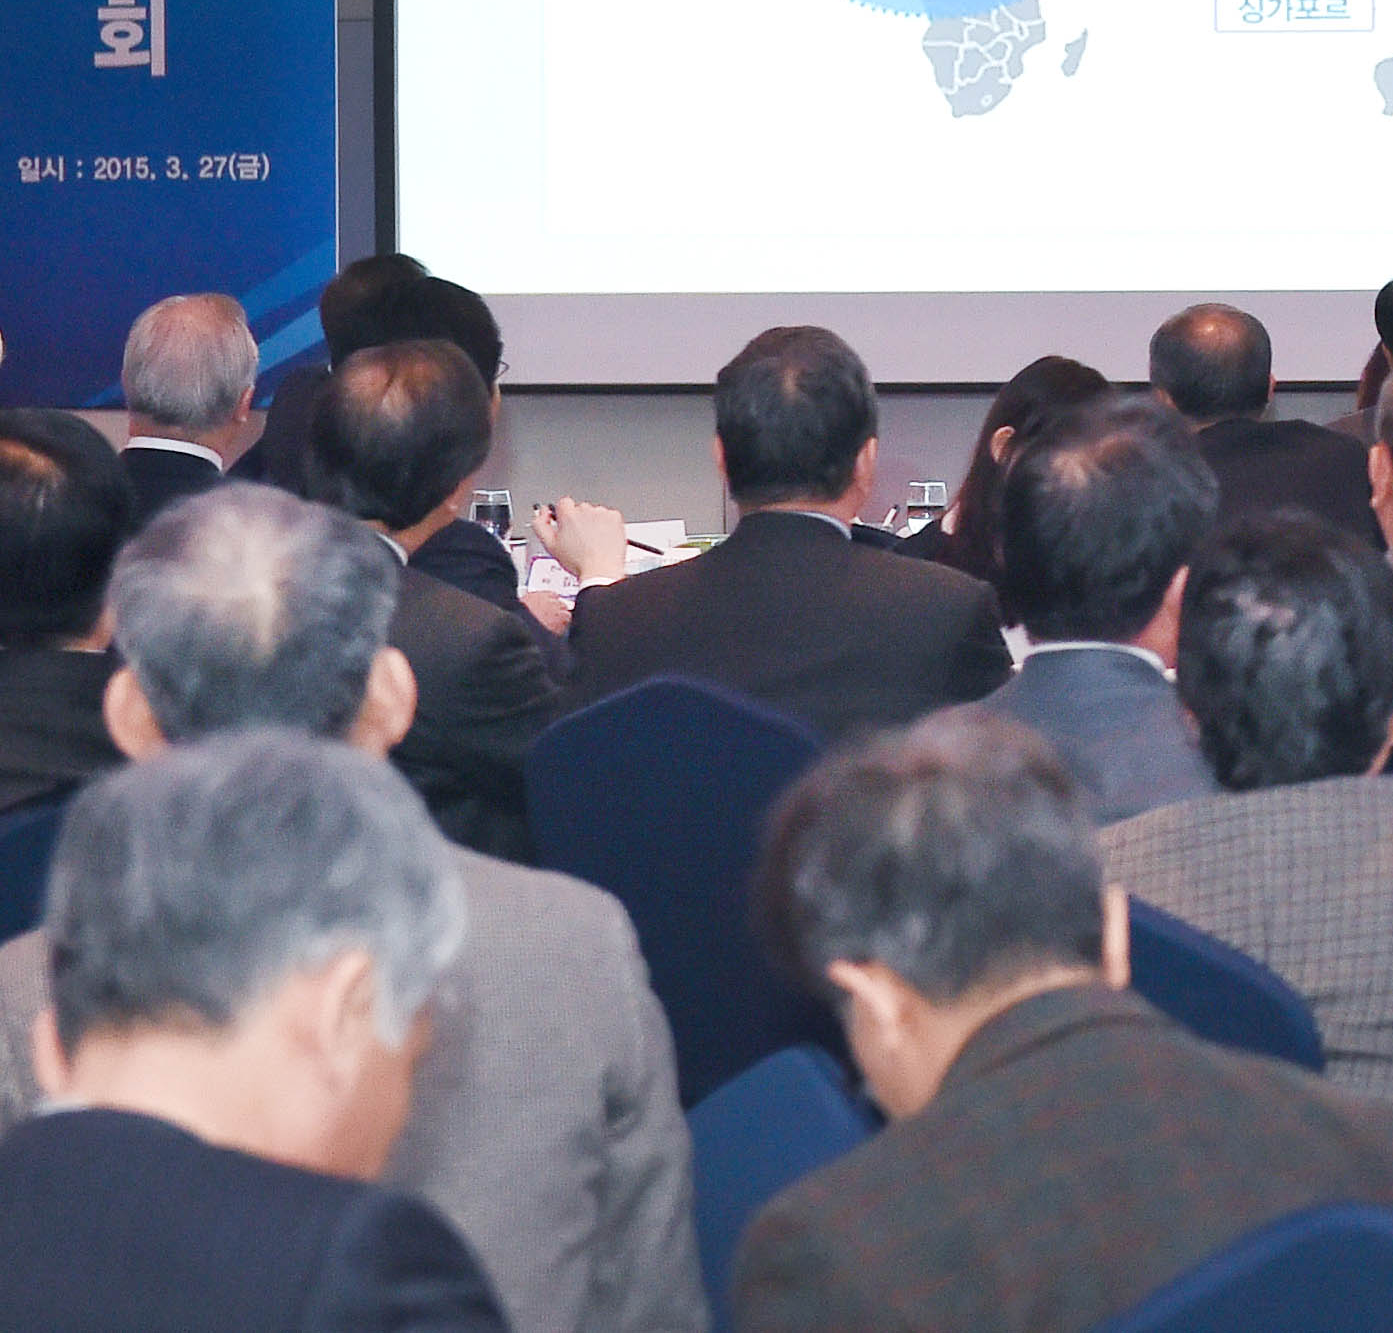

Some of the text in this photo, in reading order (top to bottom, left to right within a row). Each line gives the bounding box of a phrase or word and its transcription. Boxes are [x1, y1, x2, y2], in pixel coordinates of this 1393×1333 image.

[18, 156, 64, 182] 일시
[94, 156, 155, 180] 2015.
[166, 156, 188, 180] 3.
[199, 153, 269, 181] 27(금)
